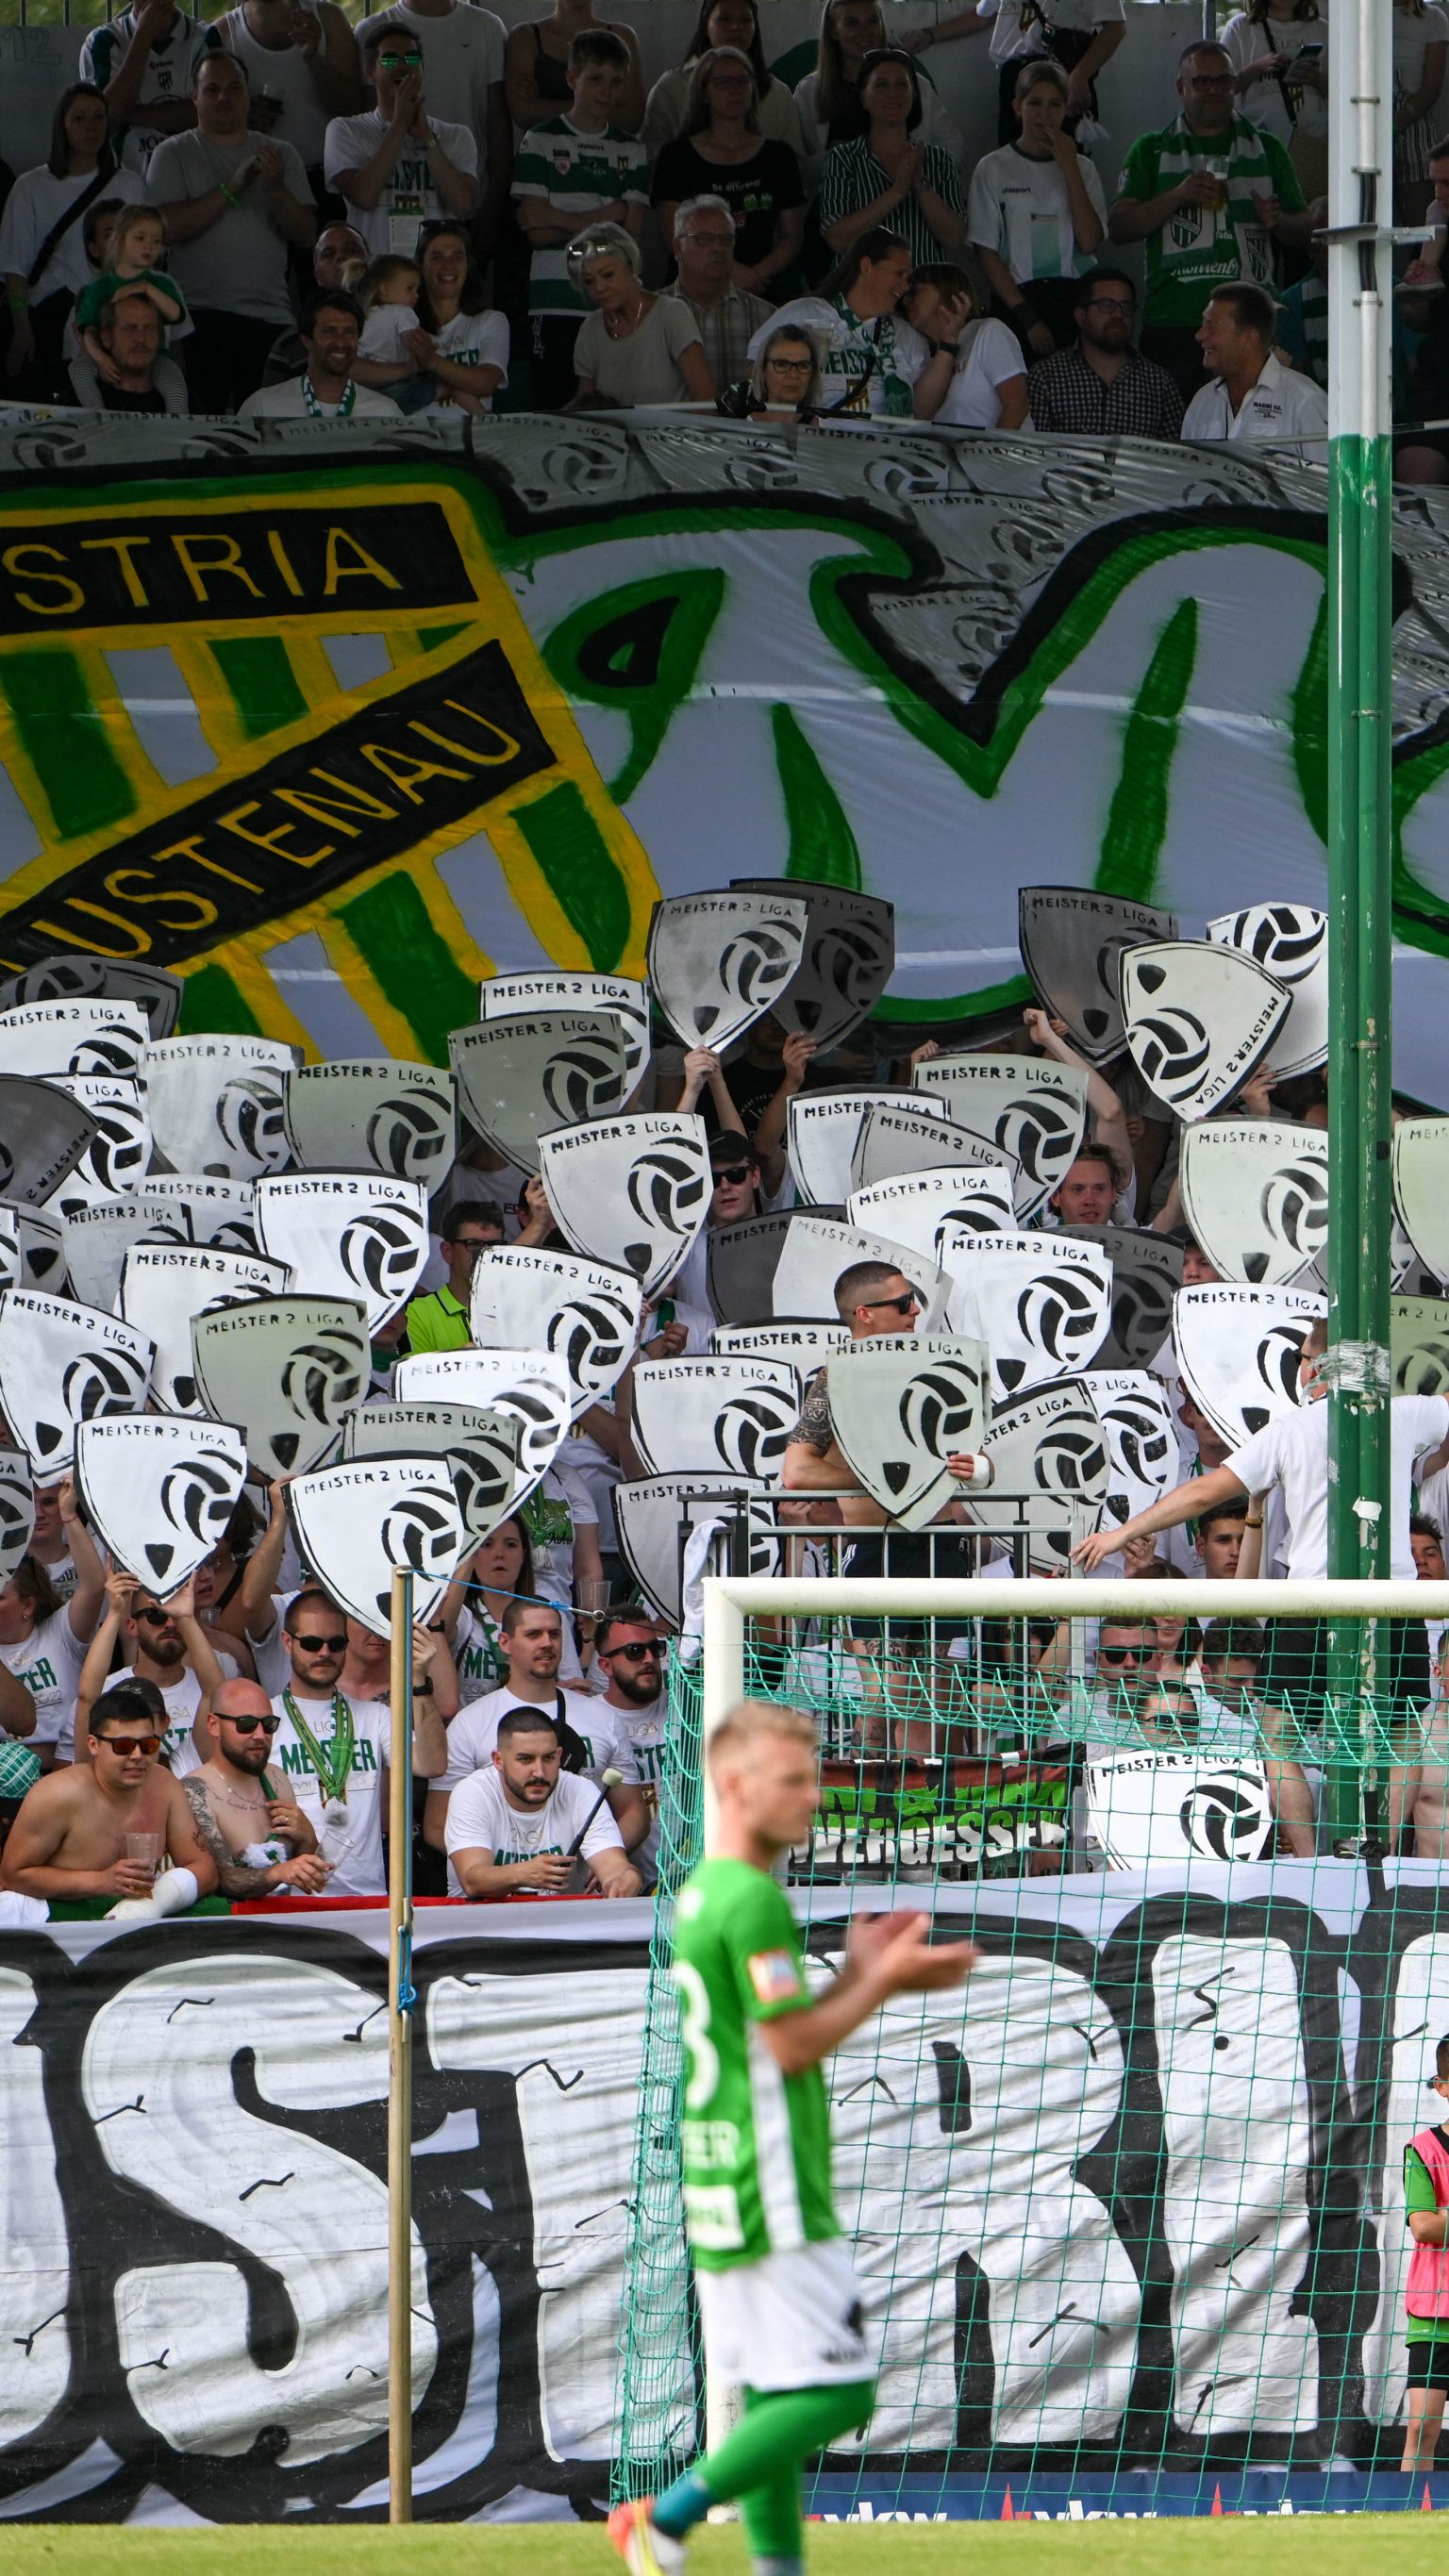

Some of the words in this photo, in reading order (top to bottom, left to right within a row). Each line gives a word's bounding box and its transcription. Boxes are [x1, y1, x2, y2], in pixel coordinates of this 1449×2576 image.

[577, 426, 612, 438] LIGA
[805, 427, 877, 441] MEISTER
[899, 440, 935, 454] LIGA
[914, 498, 987, 507] MEISTER
[2, 527, 403, 615] STRIA
[2, 699, 521, 960] USTENAU
[671, 902, 737, 915] MEISTER
[743, 903, 751, 911] 2
[760, 904, 791, 917] LIGA
[1032, 898, 1100, 912] MEISTER
[1105, 905, 1113, 915] 2
[1124, 907, 1157, 926] LIGA
[493, 983, 566, 997] MEISTER
[572, 983, 582, 993] 2
[592, 984, 629, 998] LIGA
[0, 1010, 66, 1026] MEISTER
[71, 1008, 79, 1019] 2
[91, 1009, 125, 1020] LIGA
[464, 1024, 538, 1047] MEISTER
[543, 1022, 553, 1034] 2
[561, 1020, 600, 1031] LIGA
[1234, 996, 1280, 1068] MEISTER
[144, 1046, 215, 1061] MEISTER
[224, 1046, 230, 1056] 2
[242, 1047, 276, 1060] LIGA
[298, 1066, 373, 1078] MEISTER
[378, 1068, 388, 1077] 2
[399, 1070, 435, 1085] LIGA
[927, 1067, 1001, 1081] MEISTER
[1006, 1068, 1015, 1078] 2
[1026, 1069, 1062, 1085] LIGA
[1226, 1062, 1238, 1072] 2
[86, 1085, 122, 1096] LIGA
[1194, 1075, 1227, 1105] LIGA
[552, 1127, 622, 1154] MEISTER
[625, 1124, 636, 1135] 2
[645, 1122, 682, 1133] LIGA
[880, 1116, 948, 1144] MEISTER
[954, 1138, 962, 1150] 2
[1199, 1132, 1267, 1143] MEISTER
[1274, 1135, 1281, 1144] 2
[1293, 1138, 1325, 1153] LIGA
[39, 1129, 90, 1189] MEISTER
[145, 1184, 215, 1197] MEISTER
[222, 1188, 230, 1198] 2
[241, 1191, 253, 1202] LI
[270, 1182, 343, 1196] MEISTER
[348, 1183, 358, 1193] 2
[369, 1184, 406, 1199] LIGA
[859, 1182, 926, 1205] MEISTER
[935, 1179, 943, 1190] 2
[954, 1177, 988, 1188] LIGA
[69, 1206, 127, 1225] MEISTER
[128, 1206, 136, 1217] 2
[144, 1207, 172, 1222] LIGA
[796, 1220, 867, 1256] MEISTER
[873, 1245, 881, 1256] 2
[890, 1253, 923, 1280] LIGA
[953, 1238, 1026, 1251] MEISTER
[1033, 1242, 1041, 1253] 2
[1053, 1245, 1089, 1262] LIGA
[1134, 1246, 1169, 1265] LIGA
[137, 1255, 209, 1269] MEISTER
[216, 1260, 225, 1271] 2
[236, 1264, 270, 1283] LIGA
[491, 1255, 563, 1274] MEISTER
[570, 1268, 578, 1278] 2
[589, 1273, 622, 1293] LIGA
[1188, 1292, 1259, 1304] MEISTER
[1266, 1294, 1274, 1304] 2
[1286, 1297, 1320, 1310] LIGA
[13, 1296, 80, 1324] MEISTER
[87, 1319, 94, 1329] 2
[104, 1326, 136, 1351] LIGA
[1416, 1309, 1423, 1318] 2
[207, 1315, 278, 1335] MEISTER
[287, 1314, 294, 1323] 2
[307, 1315, 343, 1324] LIGA
[728, 1333, 802, 1351] MEISTER
[807, 1332, 817, 1344] 2
[828, 1333, 851, 1344] LIG
[837, 1340, 905, 1354] MEISTER
[910, 1340, 918, 1351] 2
[929, 1342, 962, 1355] LIGA
[412, 1362, 484, 1375] MEISTER
[492, 1361, 499, 1370] 2
[512, 1361, 550, 1375] LIGA
[644, 1366, 716, 1381] MEISTER
[721, 1366, 730, 1376] 2
[741, 1368, 777, 1382] LIGA
[1090, 1381, 1099, 1392] 2
[1107, 1379, 1139, 1389] LIGA
[364, 1411, 437, 1424] MEISTER
[442, 1413, 452, 1424] 2
[463, 1415, 499, 1433] LIGA
[984, 1420, 1019, 1445] STER
[1020, 1413, 1030, 1423] 2
[1037, 1398, 1072, 1416] LIGA
[92, 1425, 163, 1437] MEISTER
[172, 1426, 180, 1438] 2
[191, 1432, 225, 1446] LIGA
[305, 1473, 374, 1493] MEISTER
[380, 1471, 390, 1481] 2
[400, 1470, 435, 1480] LIGA
[629, 1485, 695, 1502] MEISTER
[701, 1485, 709, 1497] 2
[1102, 1755, 1179, 1777] MEISTER
[1182, 1753, 1193, 1765] 2
[1203, 1754, 1243, 1766] LIGA
